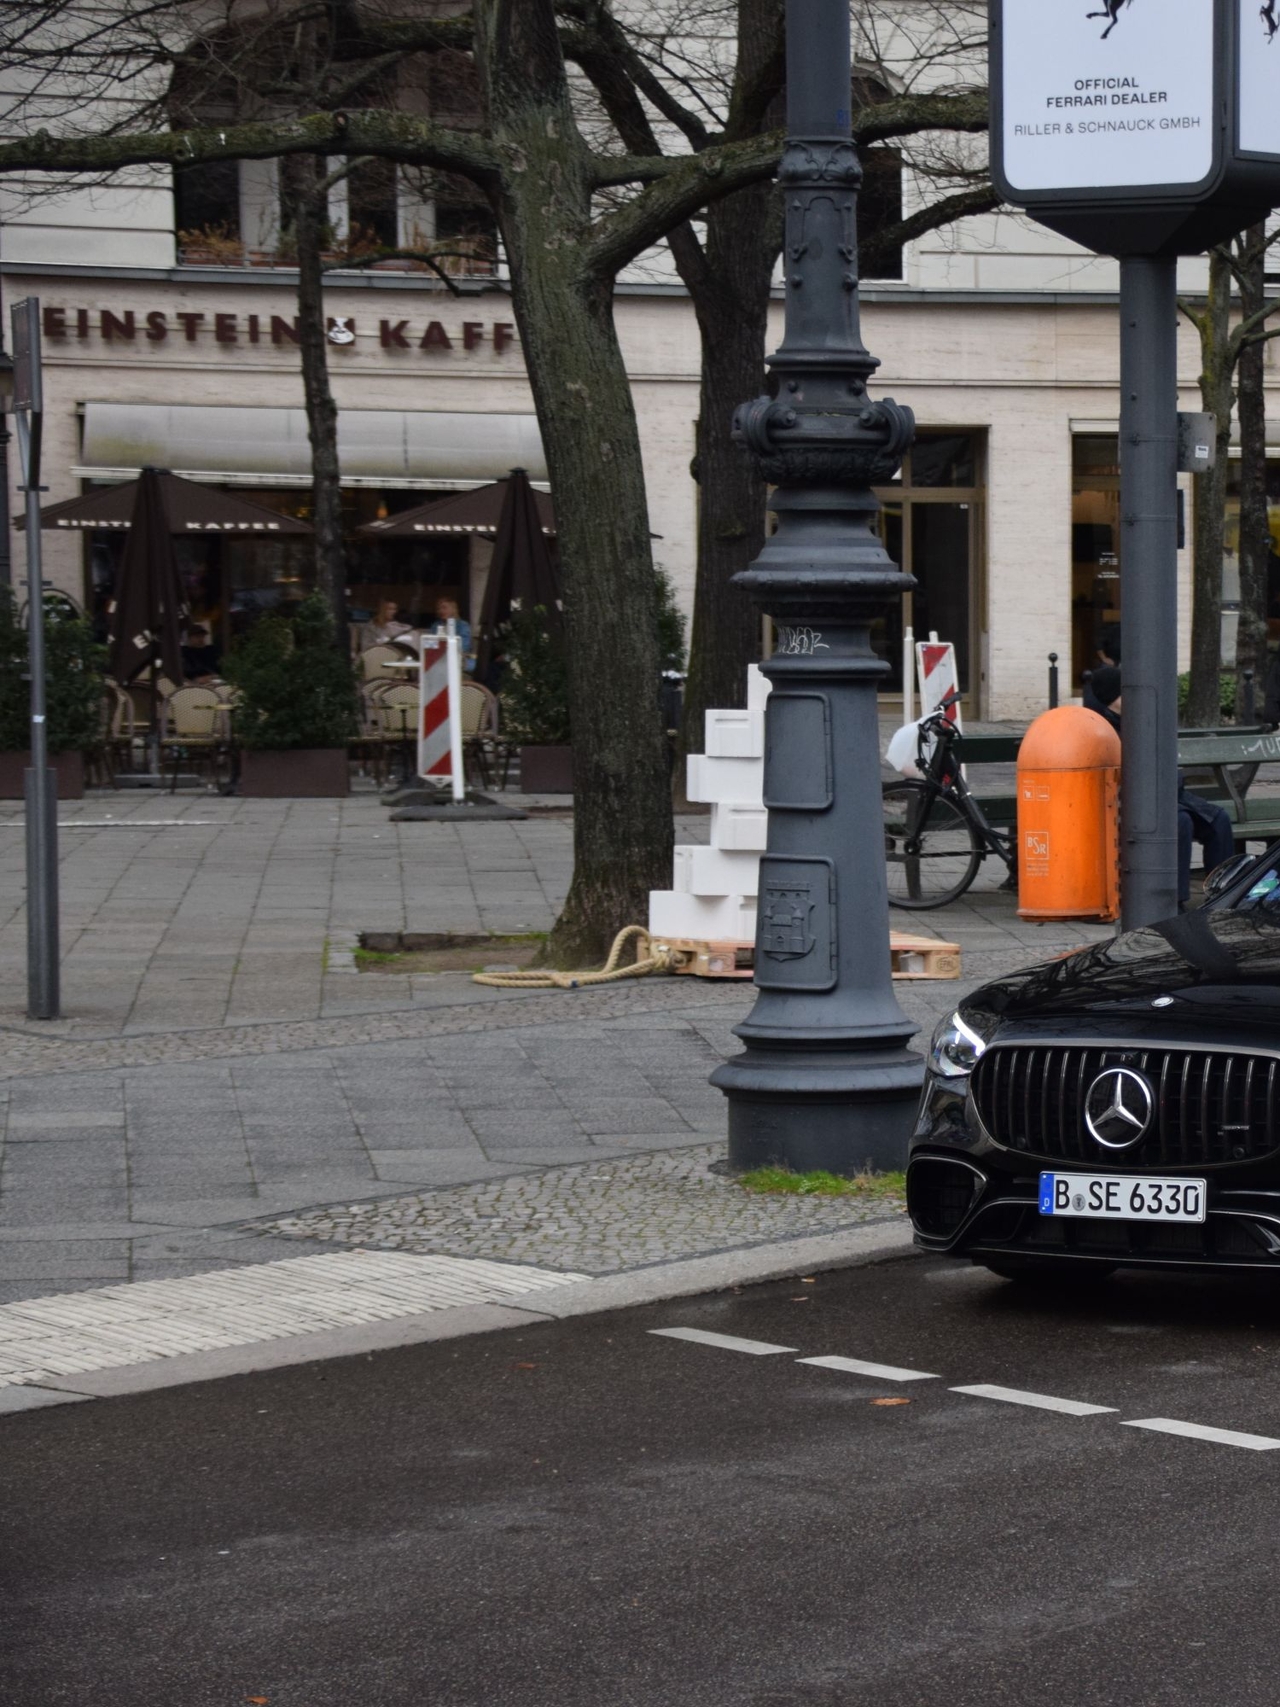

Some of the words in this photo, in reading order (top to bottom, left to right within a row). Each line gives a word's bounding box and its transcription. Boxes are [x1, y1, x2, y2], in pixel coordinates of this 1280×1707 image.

[1074, 77, 1139, 90] OFFICIAL
[1046, 96, 1107, 108] FERRARI
[1111, 92, 1167, 105] DEALER
[1014, 123, 1061, 136] RILLER
[1065, 122, 1075, 135] &
[1078, 118, 1156, 134] SCHNAUCK
[1159, 116, 1201, 130] GMBH
[43, 307, 300, 345] EINSTEIN
[379, 319, 515, 352] KAFF
[186, 521, 280, 530] KAFFEE
[413, 523, 497, 533] EINSTEI
[1027, 836, 1047, 854] BSR
[1043, 1197, 1050, 1207] D
[1055, 1179, 1070, 1210] B
[1088, 1180, 1122, 1212] SE
[1129, 1182, 1200, 1215] 6330
